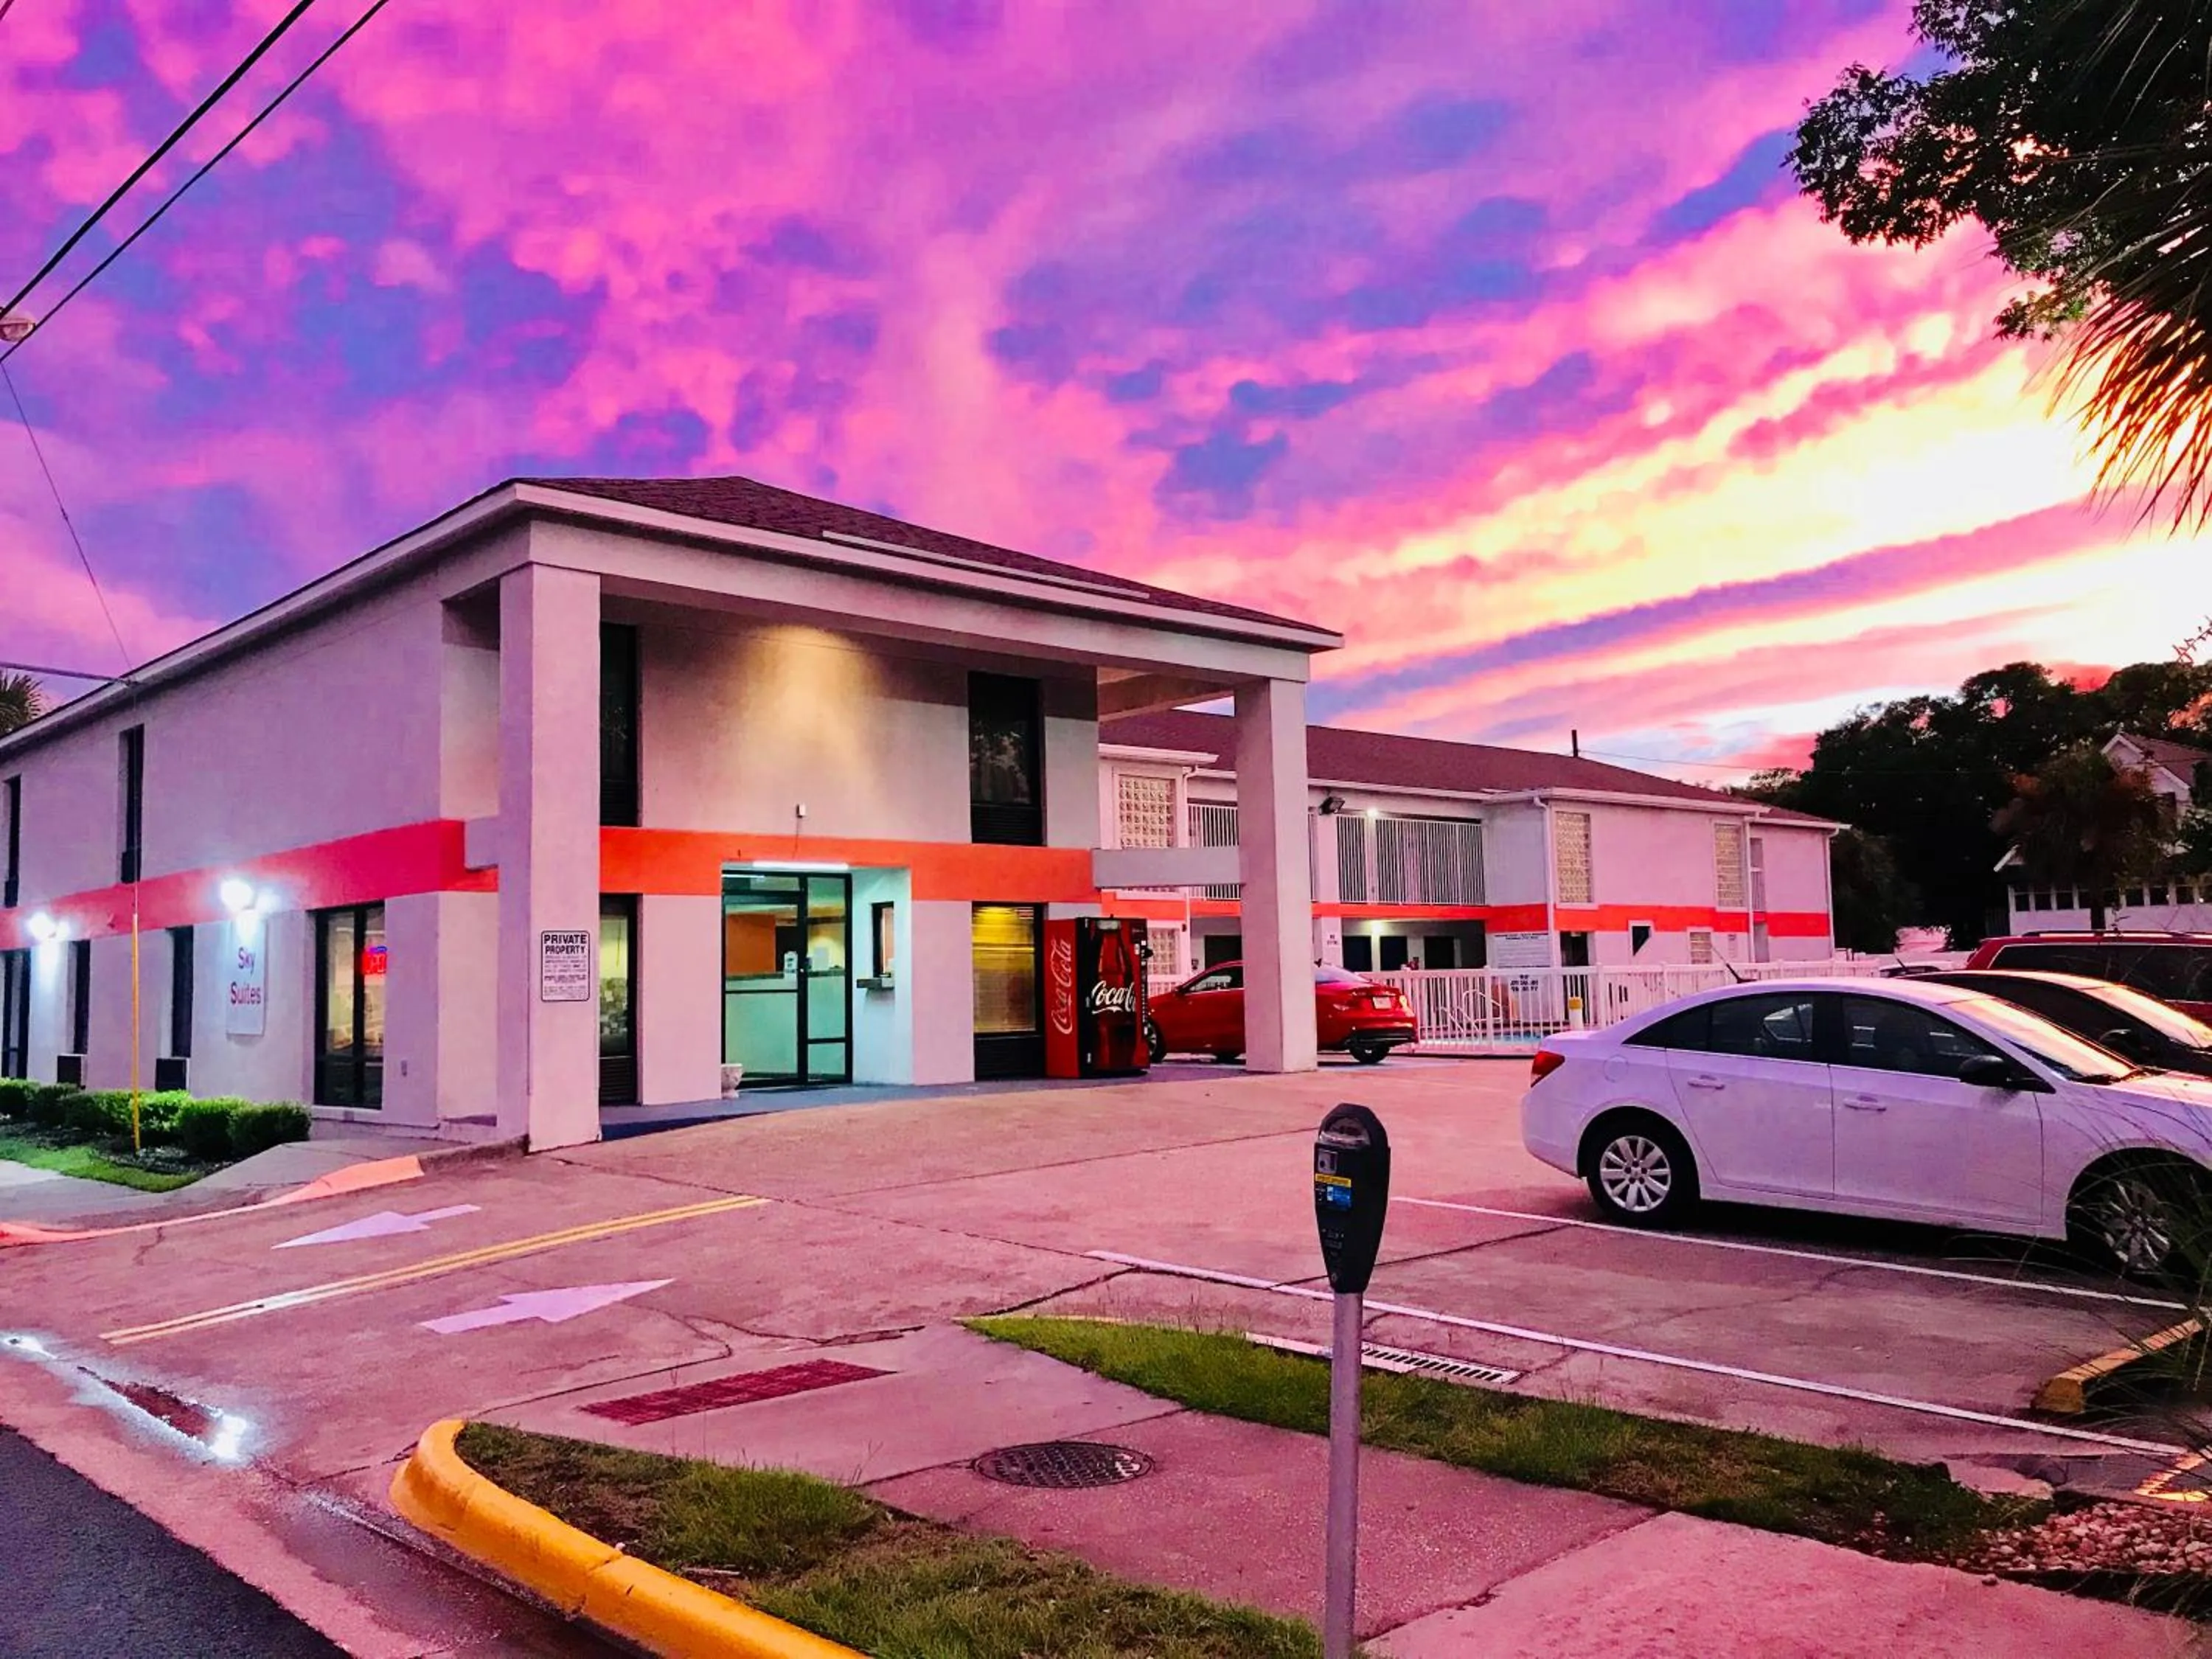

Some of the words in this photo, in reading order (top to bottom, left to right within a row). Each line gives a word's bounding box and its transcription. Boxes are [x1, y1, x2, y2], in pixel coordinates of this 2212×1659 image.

[544, 934, 587, 945] PRIVATE
[546, 945, 585, 955] PROPERTY
[230, 981, 261, 1005] Suites
